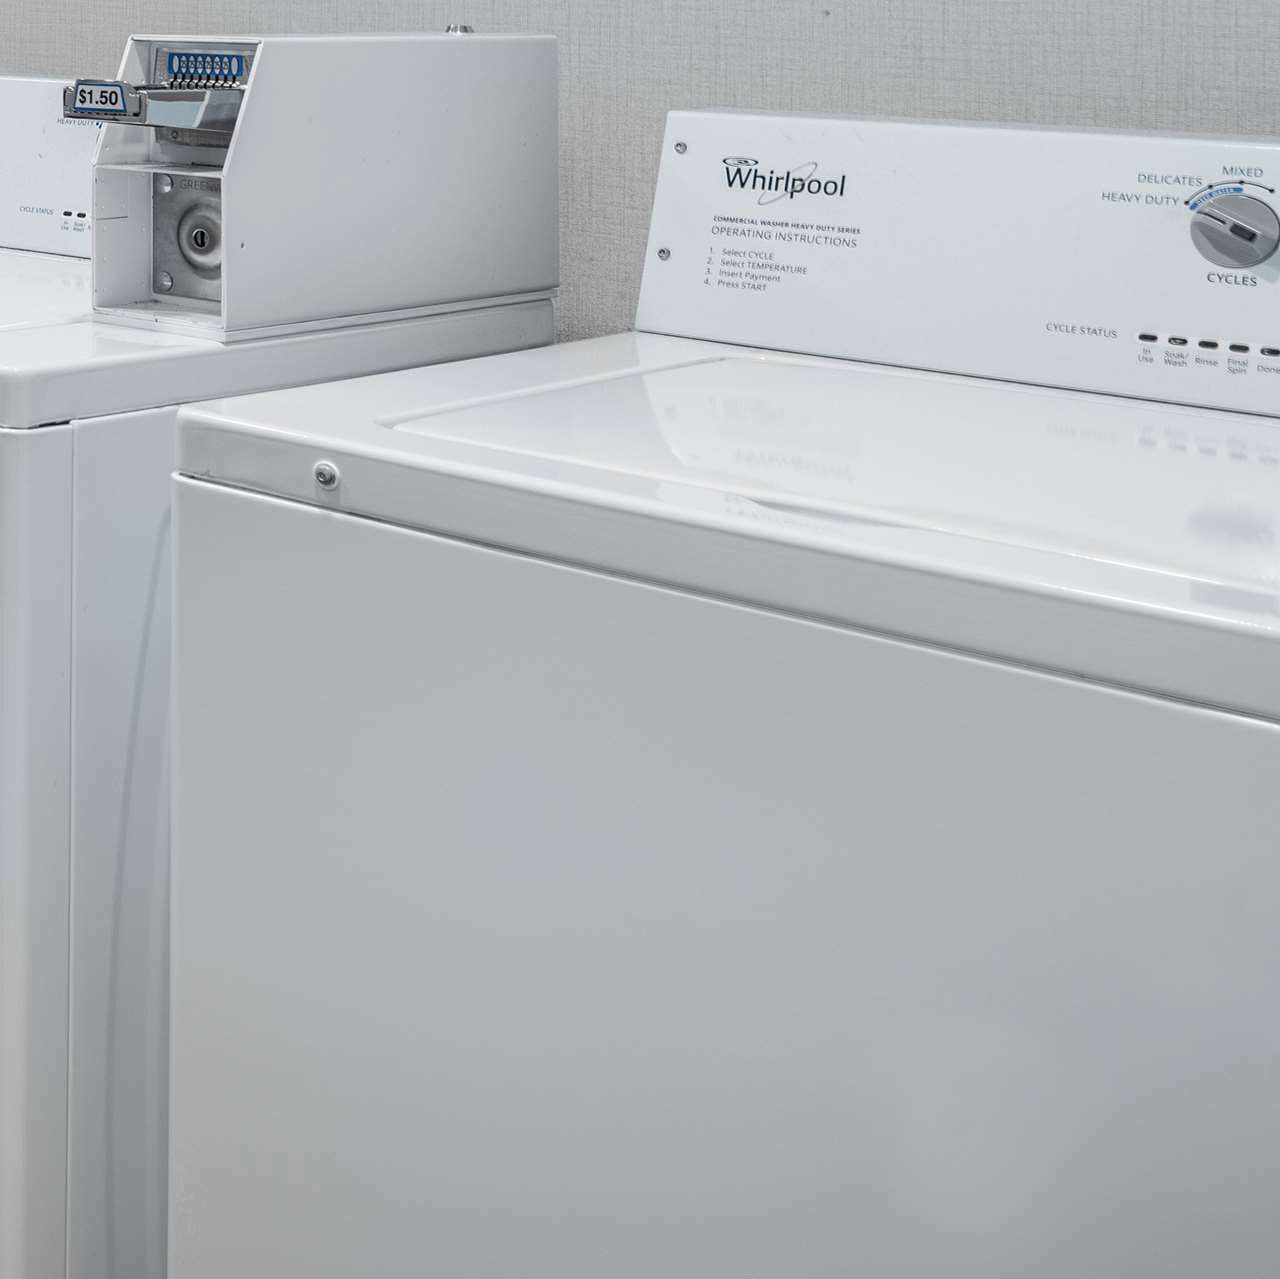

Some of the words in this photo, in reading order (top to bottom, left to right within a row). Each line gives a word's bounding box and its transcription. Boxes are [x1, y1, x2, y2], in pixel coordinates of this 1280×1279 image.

[79, 89, 118, 106] $1.50
[1222, 165, 1264, 178] MIXED
[725, 166, 846, 199] Whirlpool
[1137, 173, 1202, 187] DELICATES
[1101, 192, 1142, 204] HEAVY
[1145, 195, 1180, 207] DUTY
[713, 215, 758, 226] COMMERCIAL
[760, 219, 790, 228] WASHER
[791, 222, 814, 231] HEAVY
[816, 224, 835, 232] DUTY
[837, 226, 861, 235] SERIES
[711, 225, 772, 241] OPERATING
[774, 231, 858, 249] INSTRUCTIONS
[722, 248, 746, 259] Select
[748, 250, 775, 261] CYCLE
[720, 258, 745, 269] Select
[747, 261, 808, 275] TEMPERATURE
[719, 269, 743, 280] Insert
[745, 271, 781, 283] Payment
[1207, 273, 1258, 287] CYCLES
[718, 279, 739, 290] Press
[741, 282, 767, 292] START
[1046, 322, 1077, 335] CYCLE
[1080, 325, 1118, 339] STATUS
[1195, 356, 1219, 367] Rinse
